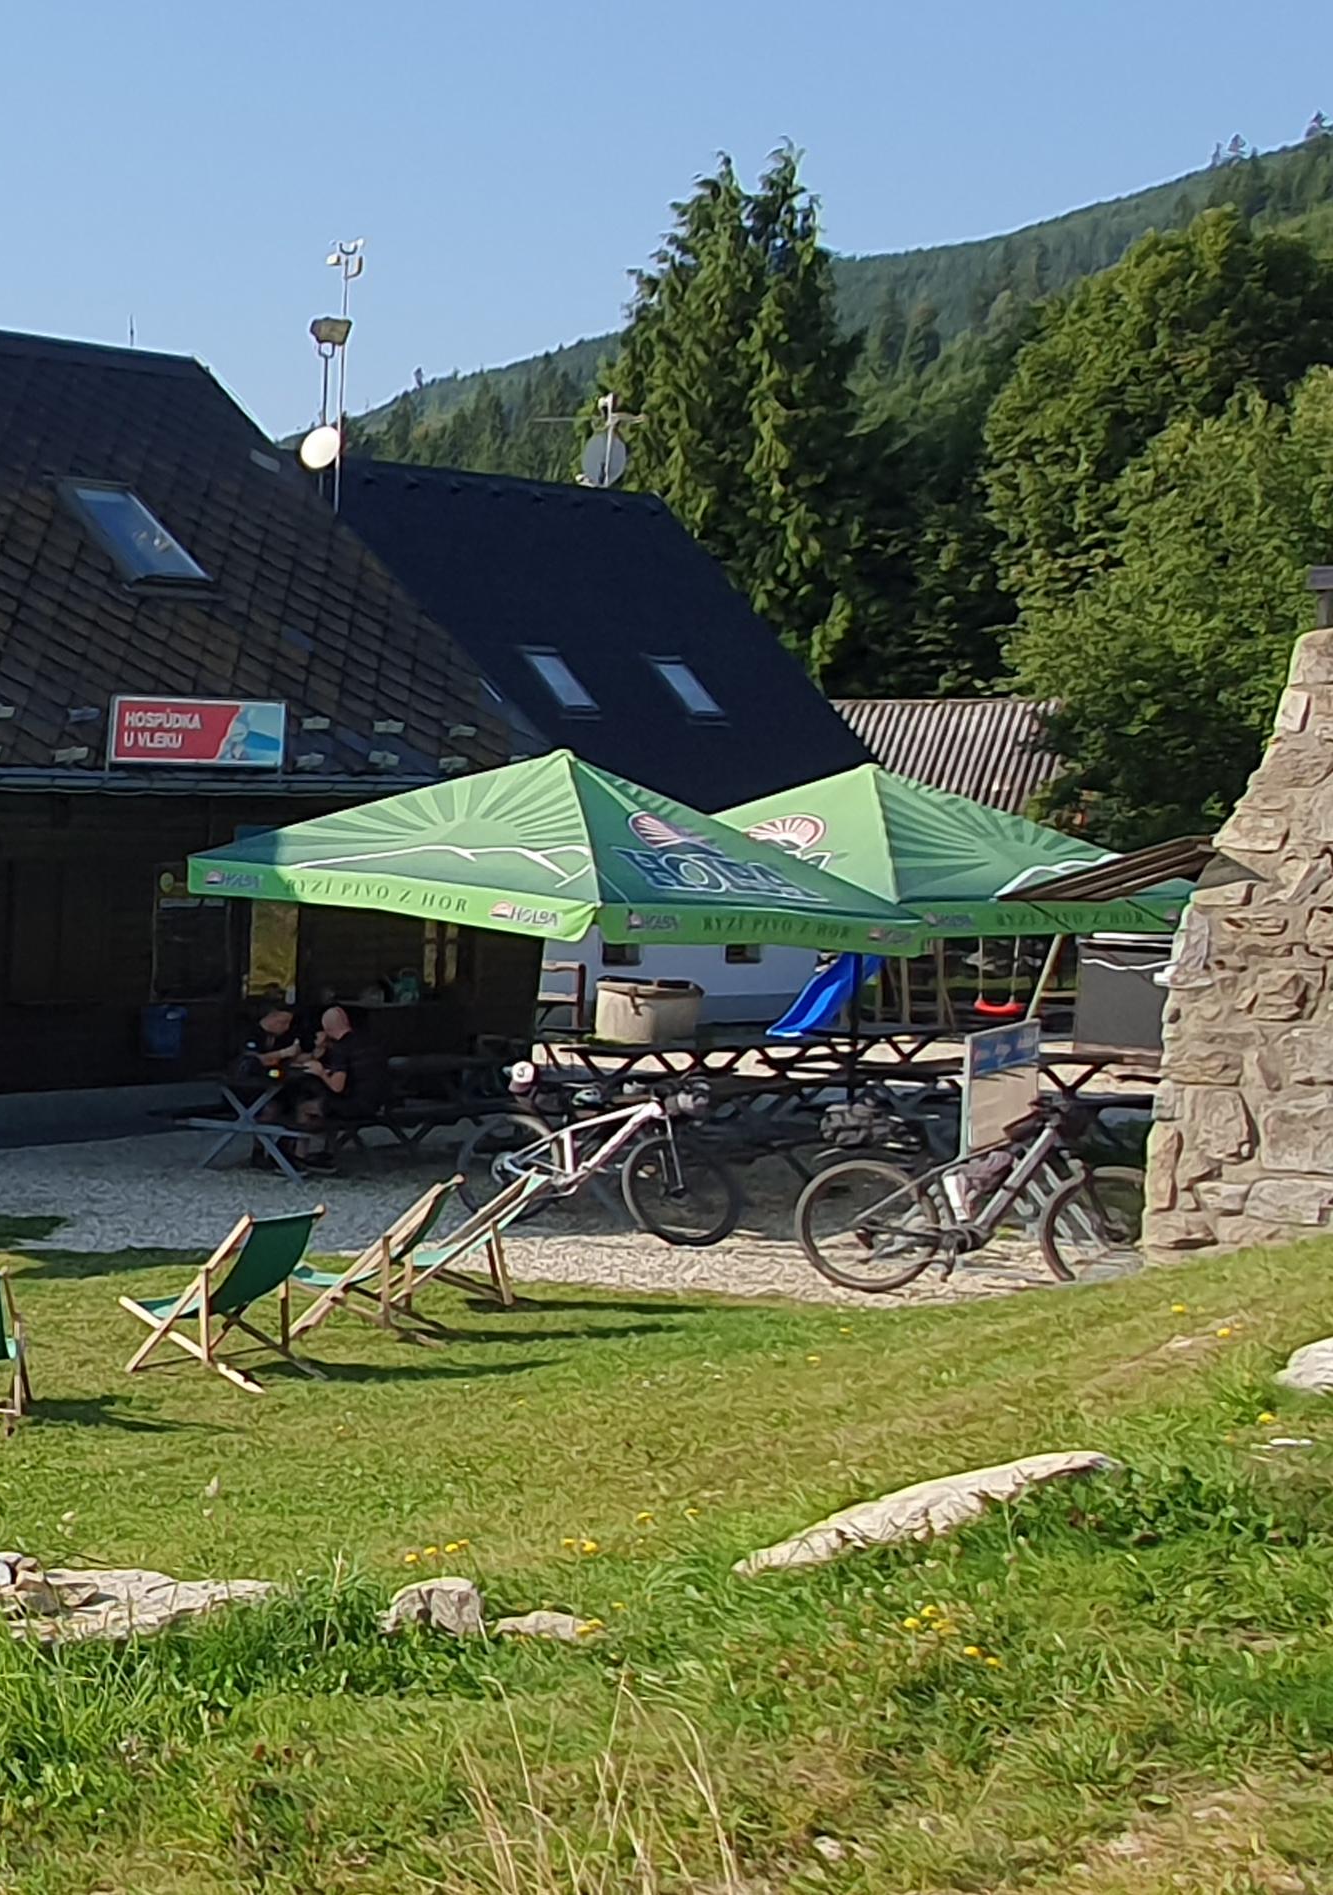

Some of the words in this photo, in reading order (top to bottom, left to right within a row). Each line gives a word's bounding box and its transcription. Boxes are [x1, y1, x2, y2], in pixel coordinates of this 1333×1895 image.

[124, 708, 201, 730] HOSPŮDKA
[123, 731, 134, 748] U
[137, 731, 182, 749] VLEKU
[609, 846, 830, 903] HOLBA
[285, 876, 333, 896] RYZÍ
[340, 882, 390, 900] PIVO
[399, 889, 412, 905] Z
[421, 893, 468, 914] HOR
[509, 905, 559, 927] HOLBA
